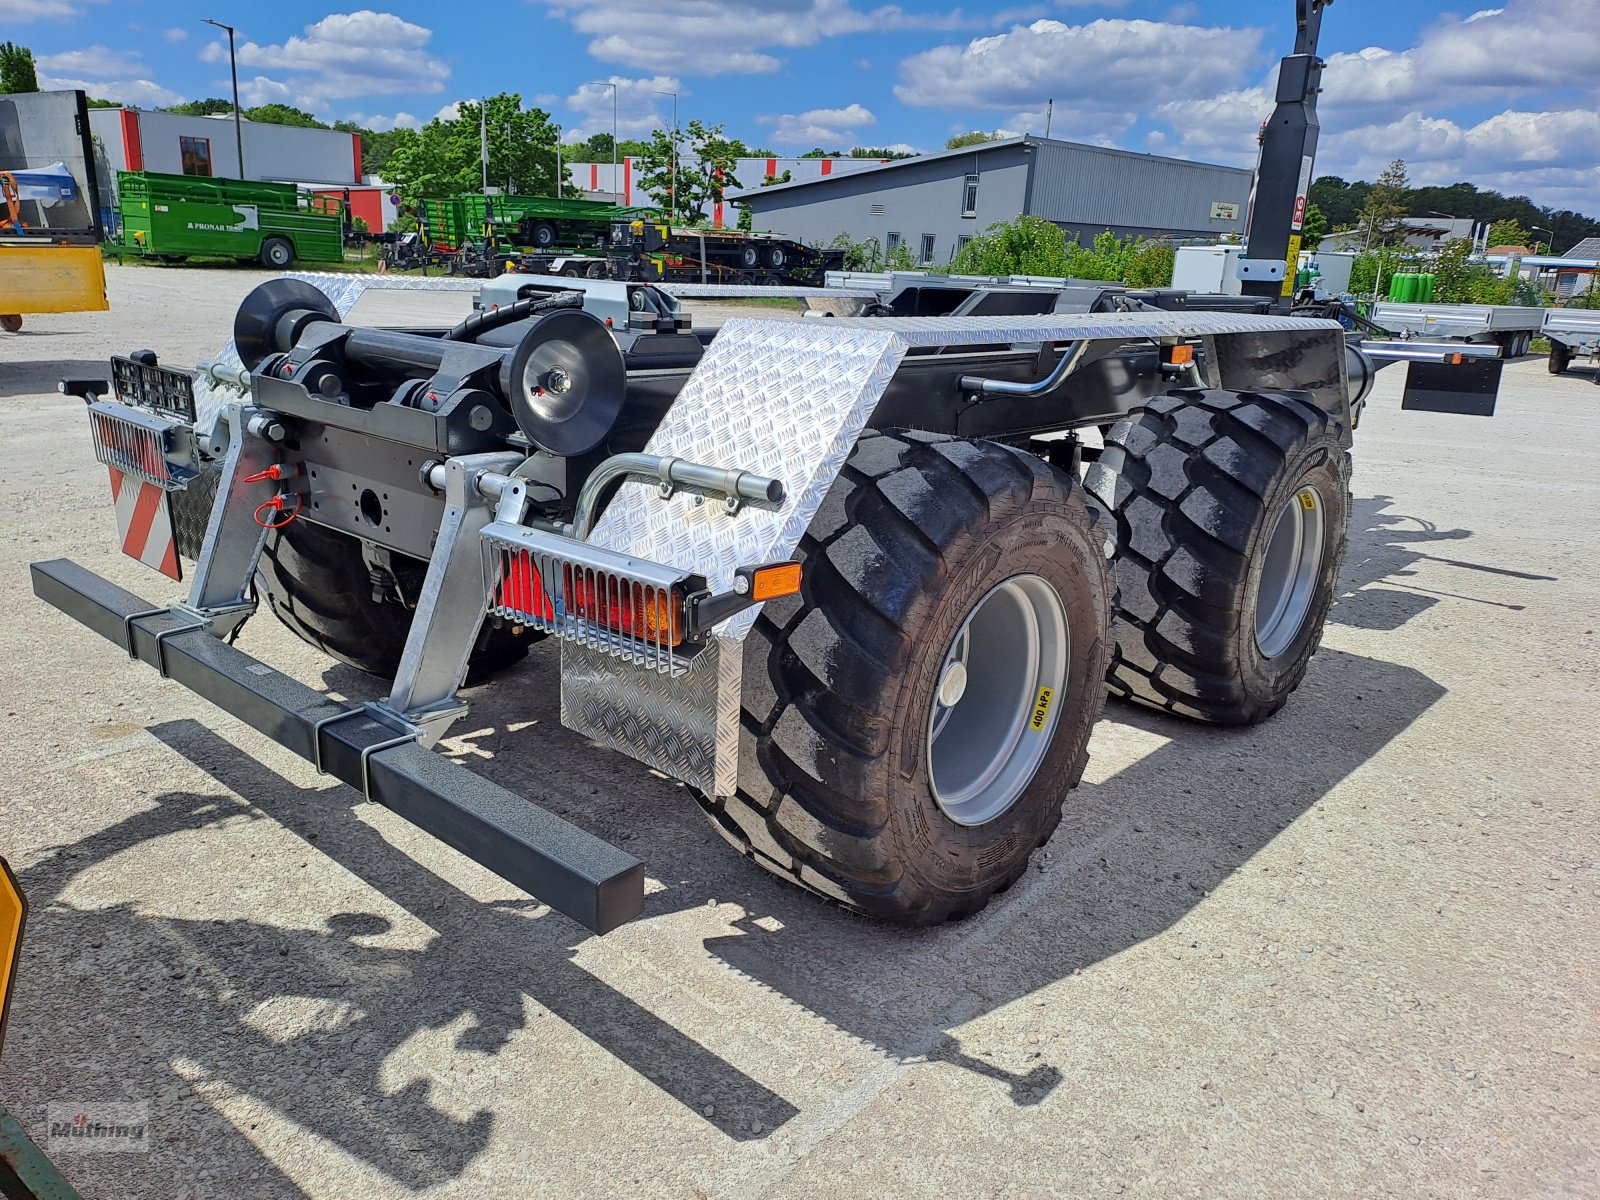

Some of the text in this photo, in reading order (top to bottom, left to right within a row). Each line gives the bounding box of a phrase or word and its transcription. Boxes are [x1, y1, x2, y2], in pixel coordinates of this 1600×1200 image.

[195, 222, 225, 231] PRONAR
[1033, 690, 1051, 728] 400 kPa
